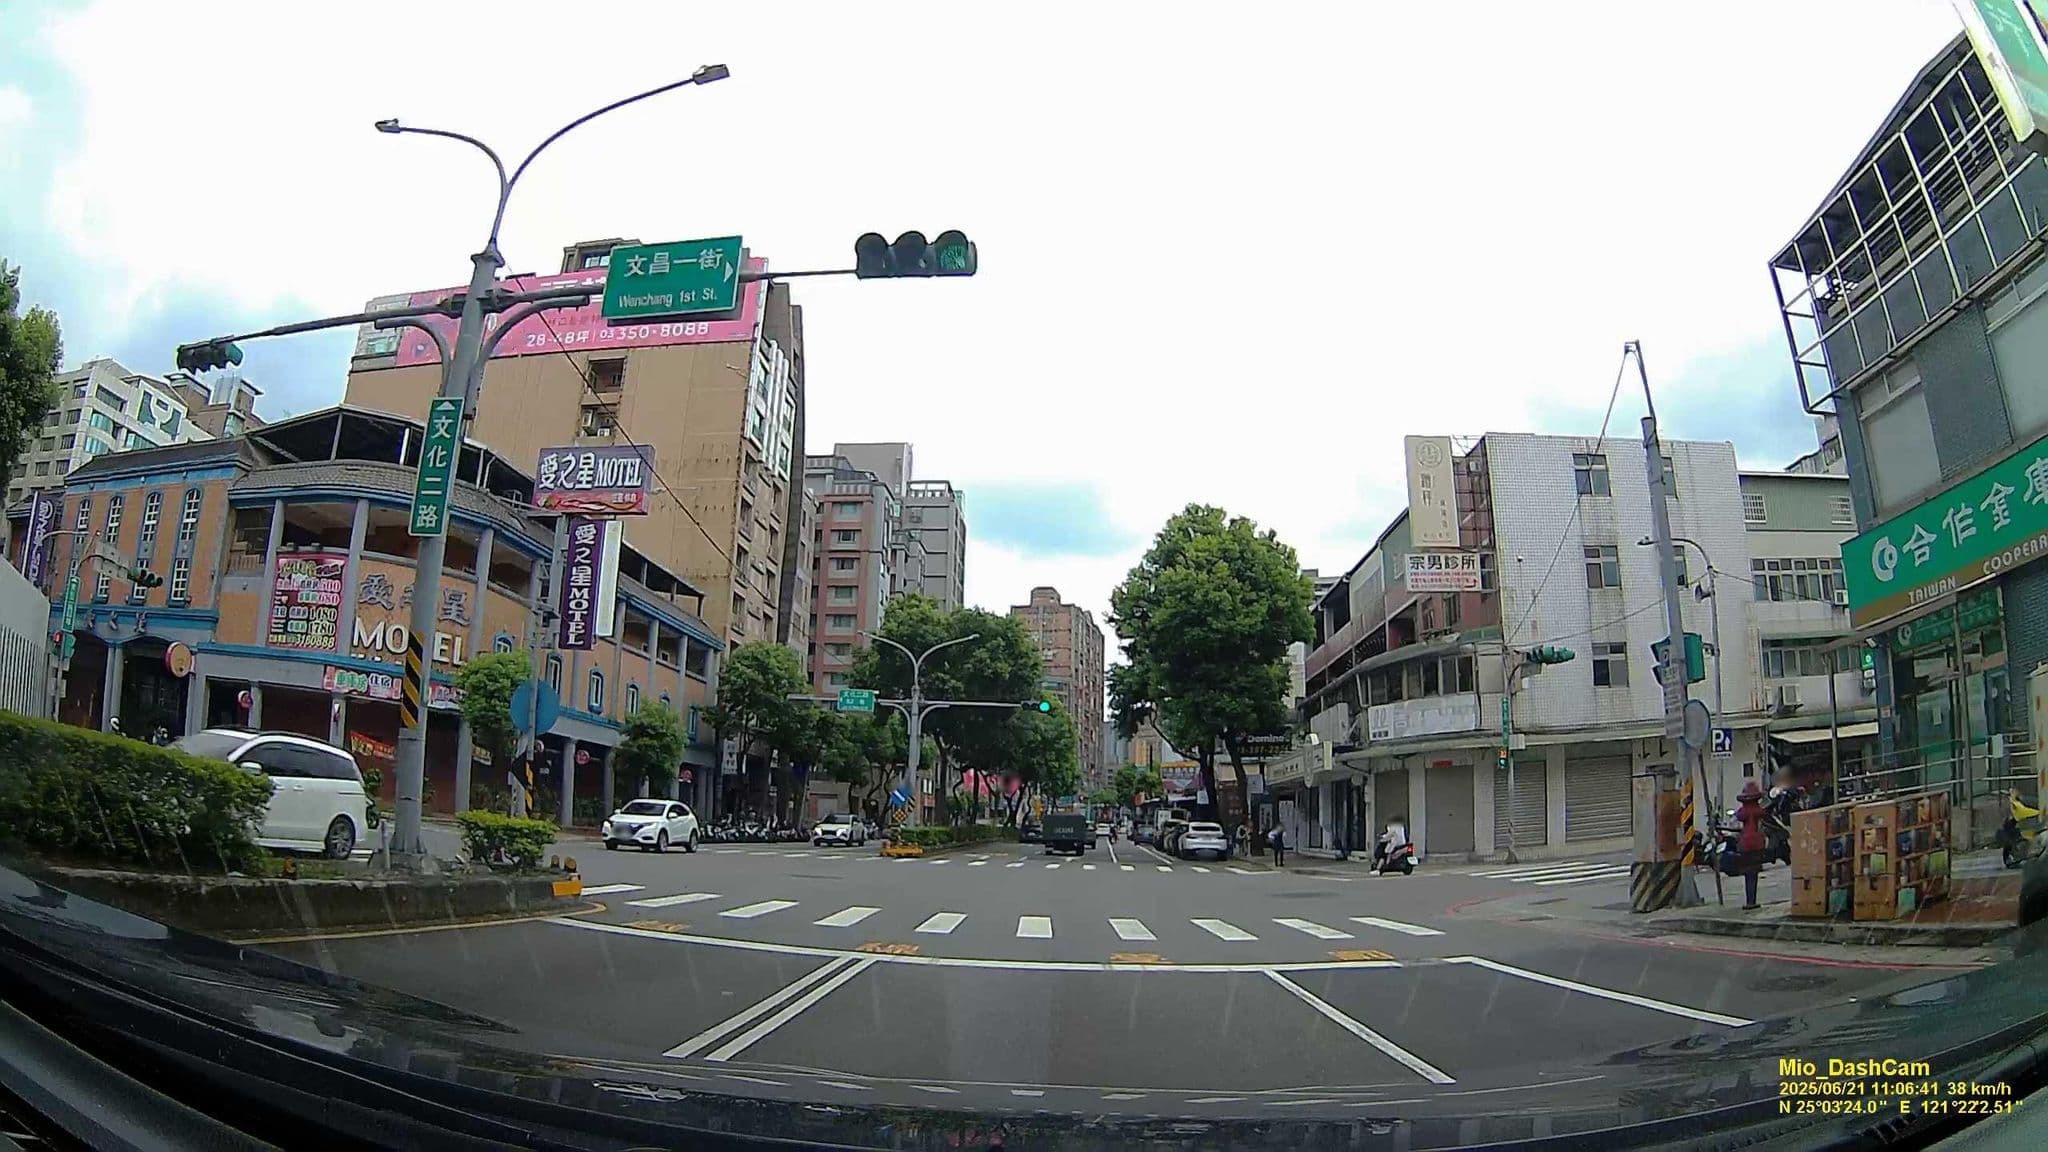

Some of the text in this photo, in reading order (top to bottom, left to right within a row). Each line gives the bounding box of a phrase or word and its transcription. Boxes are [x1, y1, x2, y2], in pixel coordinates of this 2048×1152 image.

[624, 248, 724, 277] 文昌一街
[680, 290, 696, 303] 1st
[702, 287, 717, 301] St.
[415, 415, 455, 530] 文化二路
[1409, 554, 1476, 570] 宗男診所
[1907, 575, 1957, 605] TAIWAN
[352, 616, 468, 667] MOEL
[1712, 729, 1724, 752] P
